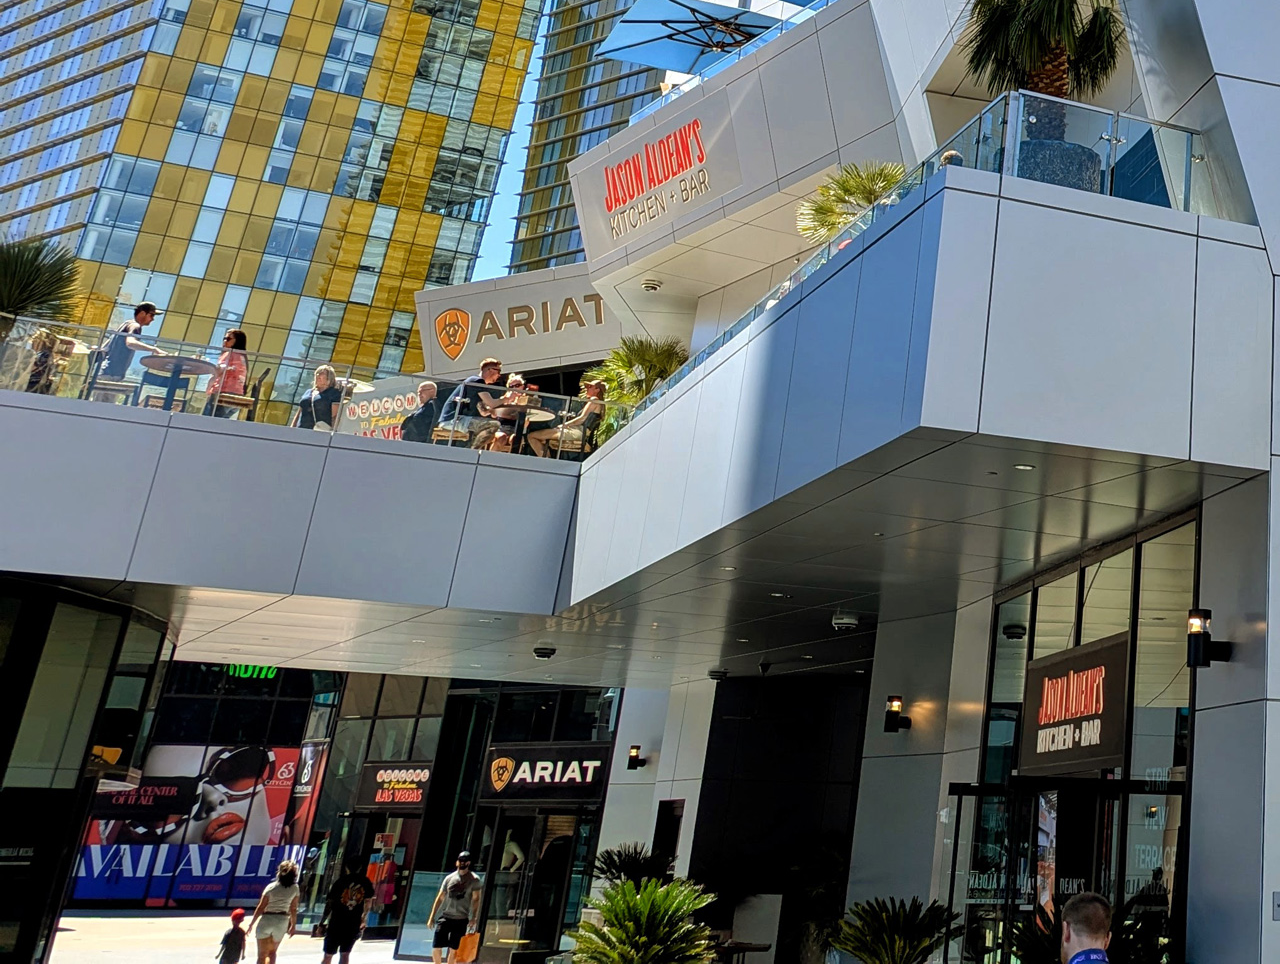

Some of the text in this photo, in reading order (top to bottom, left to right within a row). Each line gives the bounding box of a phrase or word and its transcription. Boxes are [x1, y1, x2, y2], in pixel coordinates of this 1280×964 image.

[603, 117, 707, 213] JASON ALDEAN'S
[608, 190, 668, 241] KITCHEN
[678, 167, 712, 204] BAR
[475, 292, 605, 344] ARIAT
[347, 392, 417, 420] WELCOM
[1038, 665, 1106, 726] JASON ALDEAN'S
[1036, 723, 1074, 753] KITCHEN
[1080, 718, 1102, 747] BAR
[376, 769, 430, 783] WELCOME
[512, 760, 602, 783] ARIAT
[375, 789, 423, 803] LAS VEGAS
[1134, 844, 1177, 872] TERRACE
